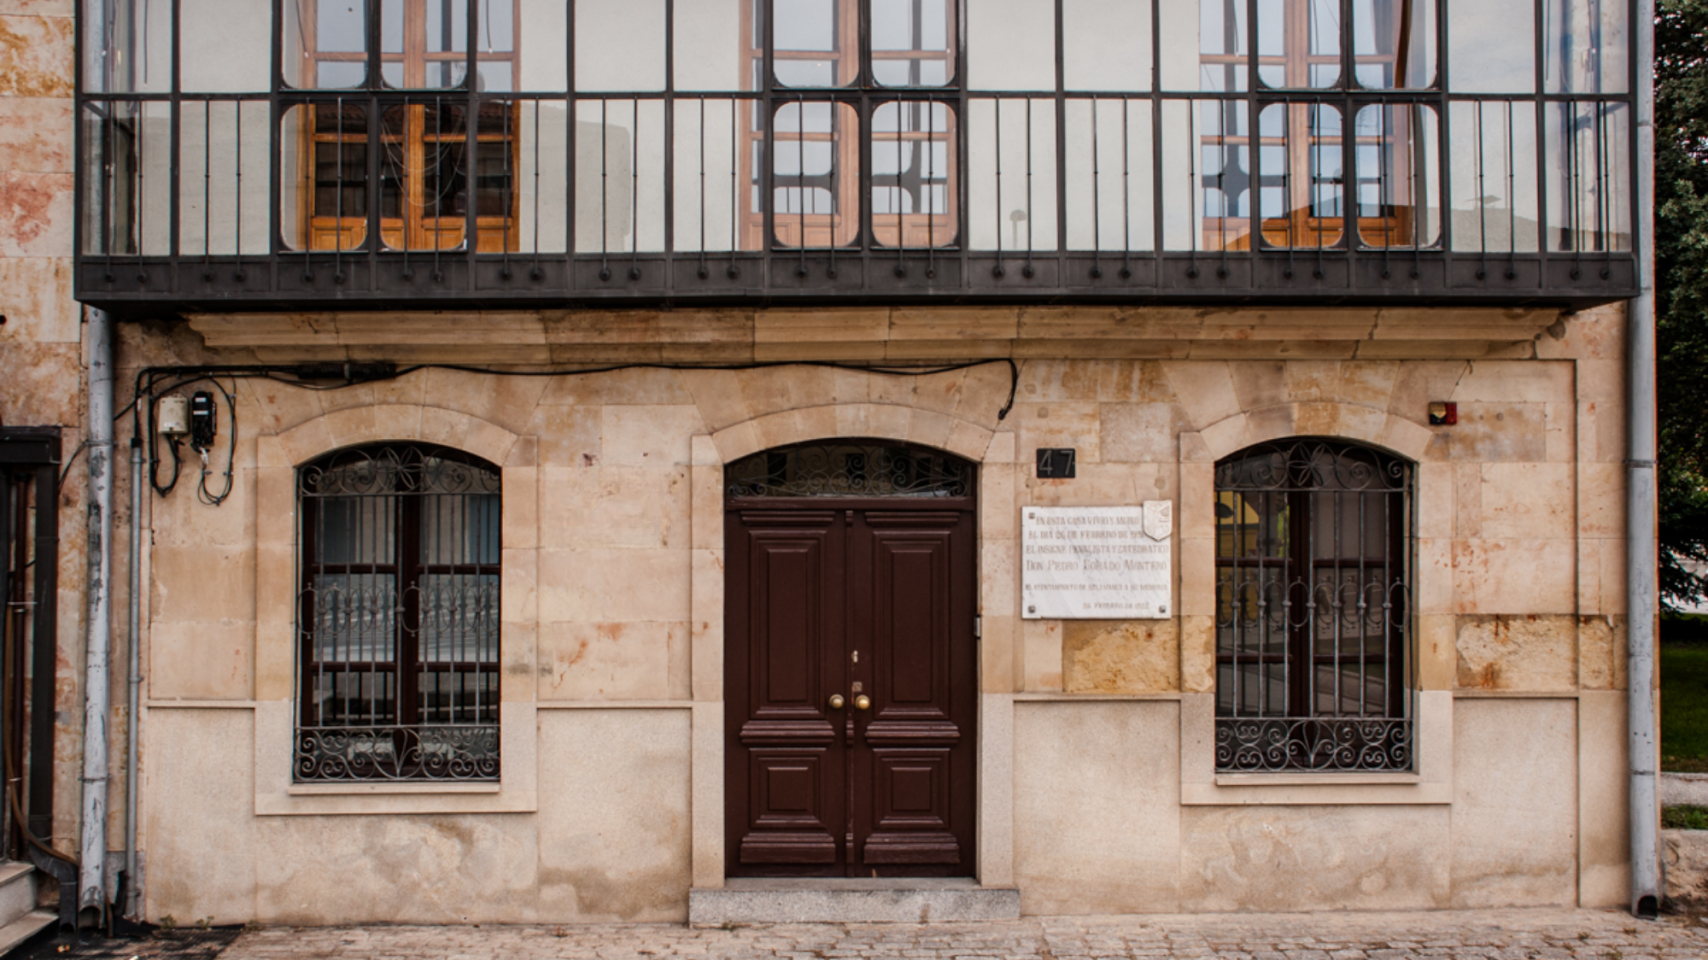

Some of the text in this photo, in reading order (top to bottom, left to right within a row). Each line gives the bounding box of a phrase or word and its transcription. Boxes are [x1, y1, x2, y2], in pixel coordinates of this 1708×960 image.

[1039, 450, 1073, 475] 47
[1046, 516, 1066, 526] ESTA
[1080, 530, 1116, 540] FEBRERO
[1118, 530, 1128, 540] DE
[1026, 545, 1036, 554] EL
[1047, 560, 1079, 571] PEDRO
[1124, 560, 1167, 571] MONTERO
